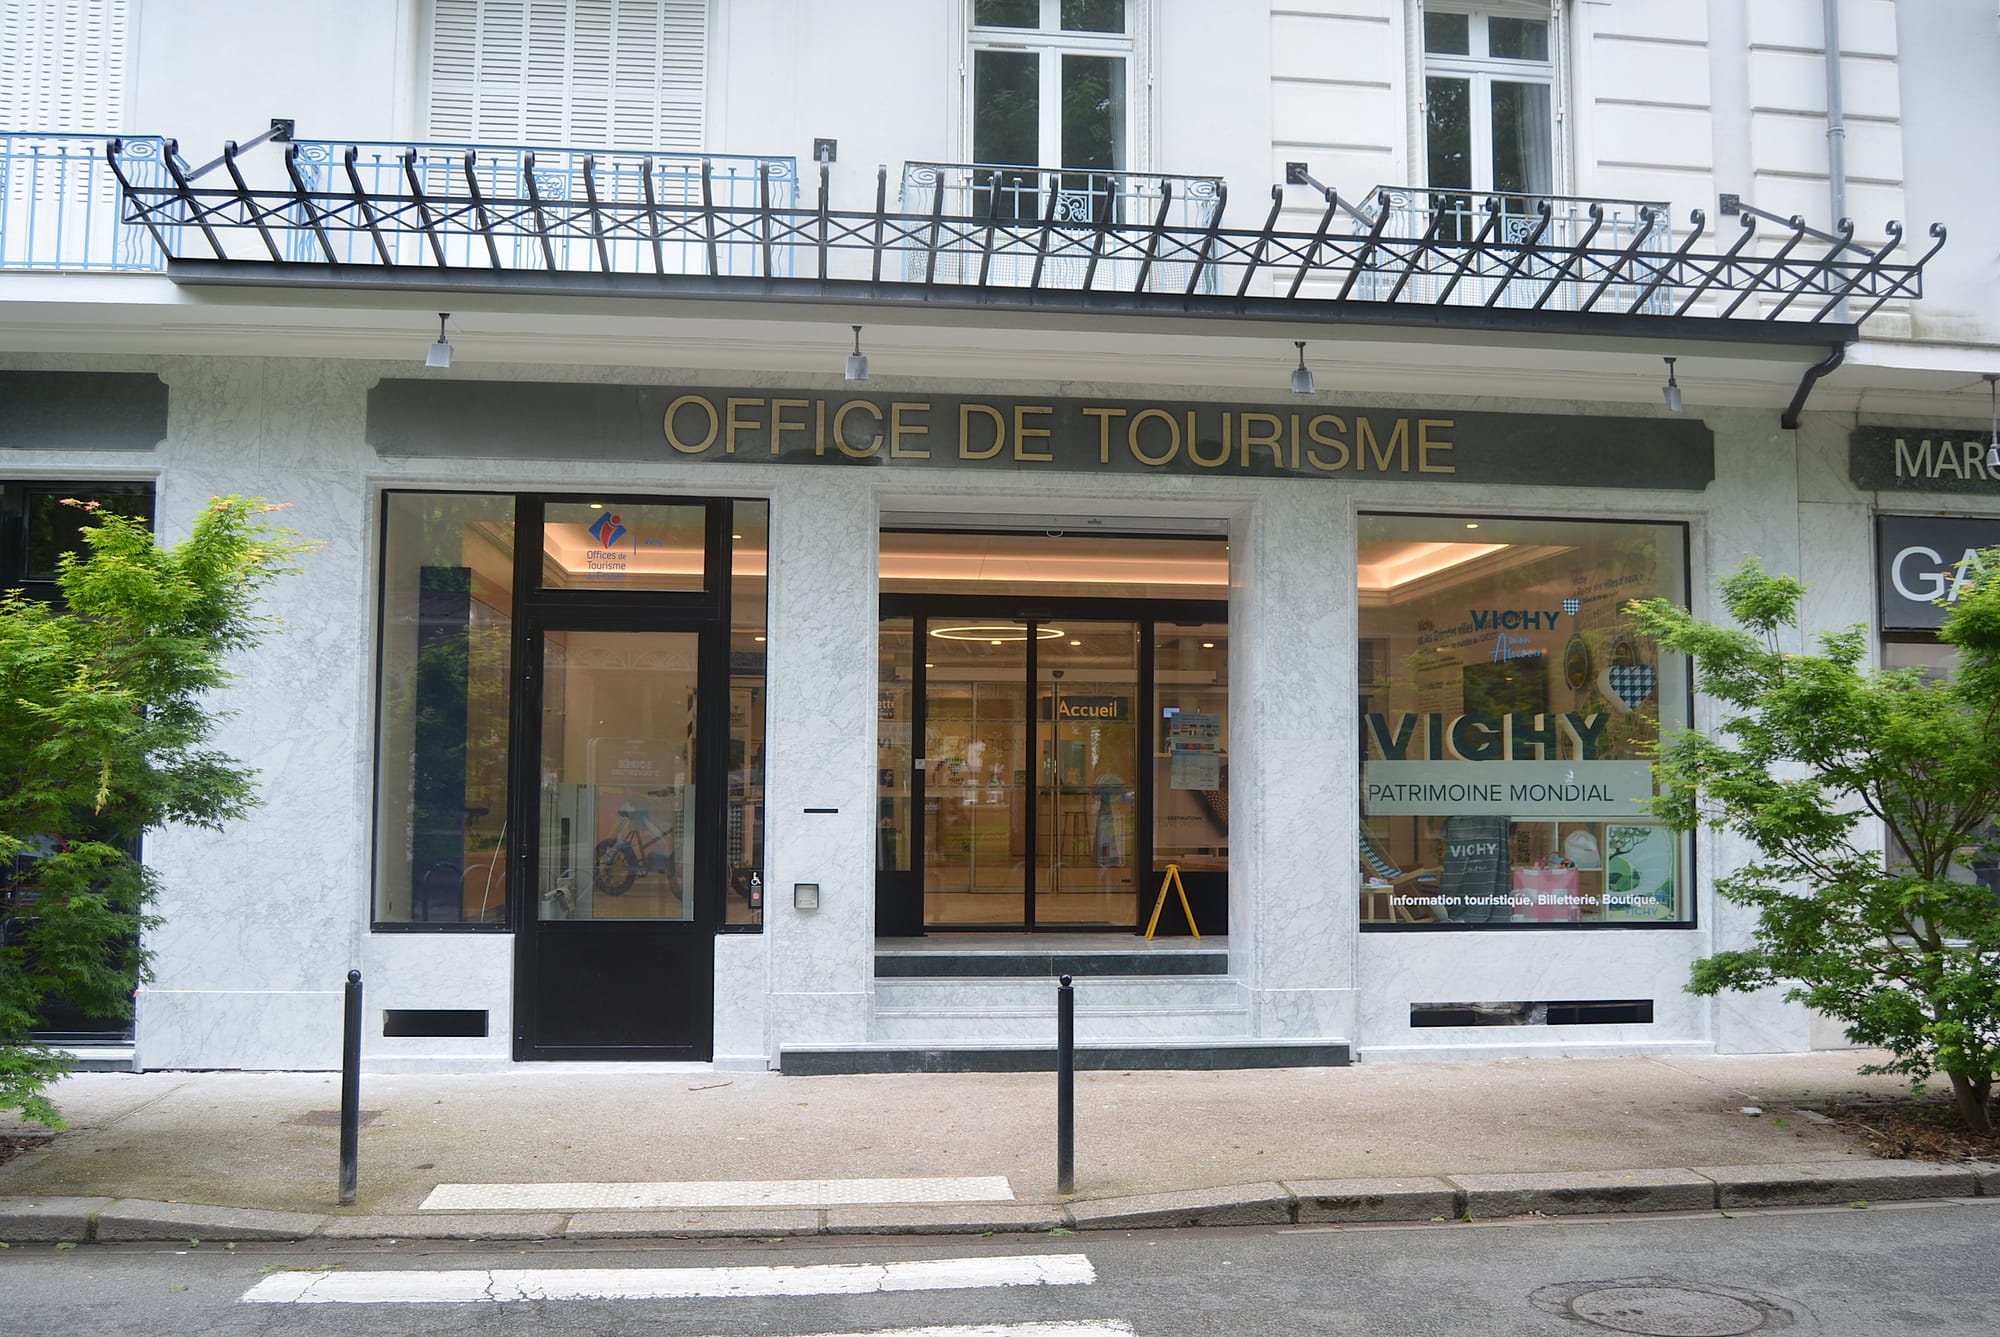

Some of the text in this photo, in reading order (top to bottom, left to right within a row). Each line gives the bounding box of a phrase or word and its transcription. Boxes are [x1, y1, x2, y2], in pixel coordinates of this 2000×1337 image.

[663, 394, 1456, 474] OFFICE DE TOURISME
[586, 550, 627, 560] Offices de
[586, 560, 627, 570] Tourisme
[1470, 610, 1560, 631] VICHY
[1059, 699, 1118, 718] Accueil
[1364, 712, 1610, 762] VICHY
[1368, 783, 1615, 802] PATRIMOINE MONDIAL
[1450, 842, 1498, 858] VICHY
[1389, 893, 1660, 908] Information touristique, Billetterie, Boutique.
